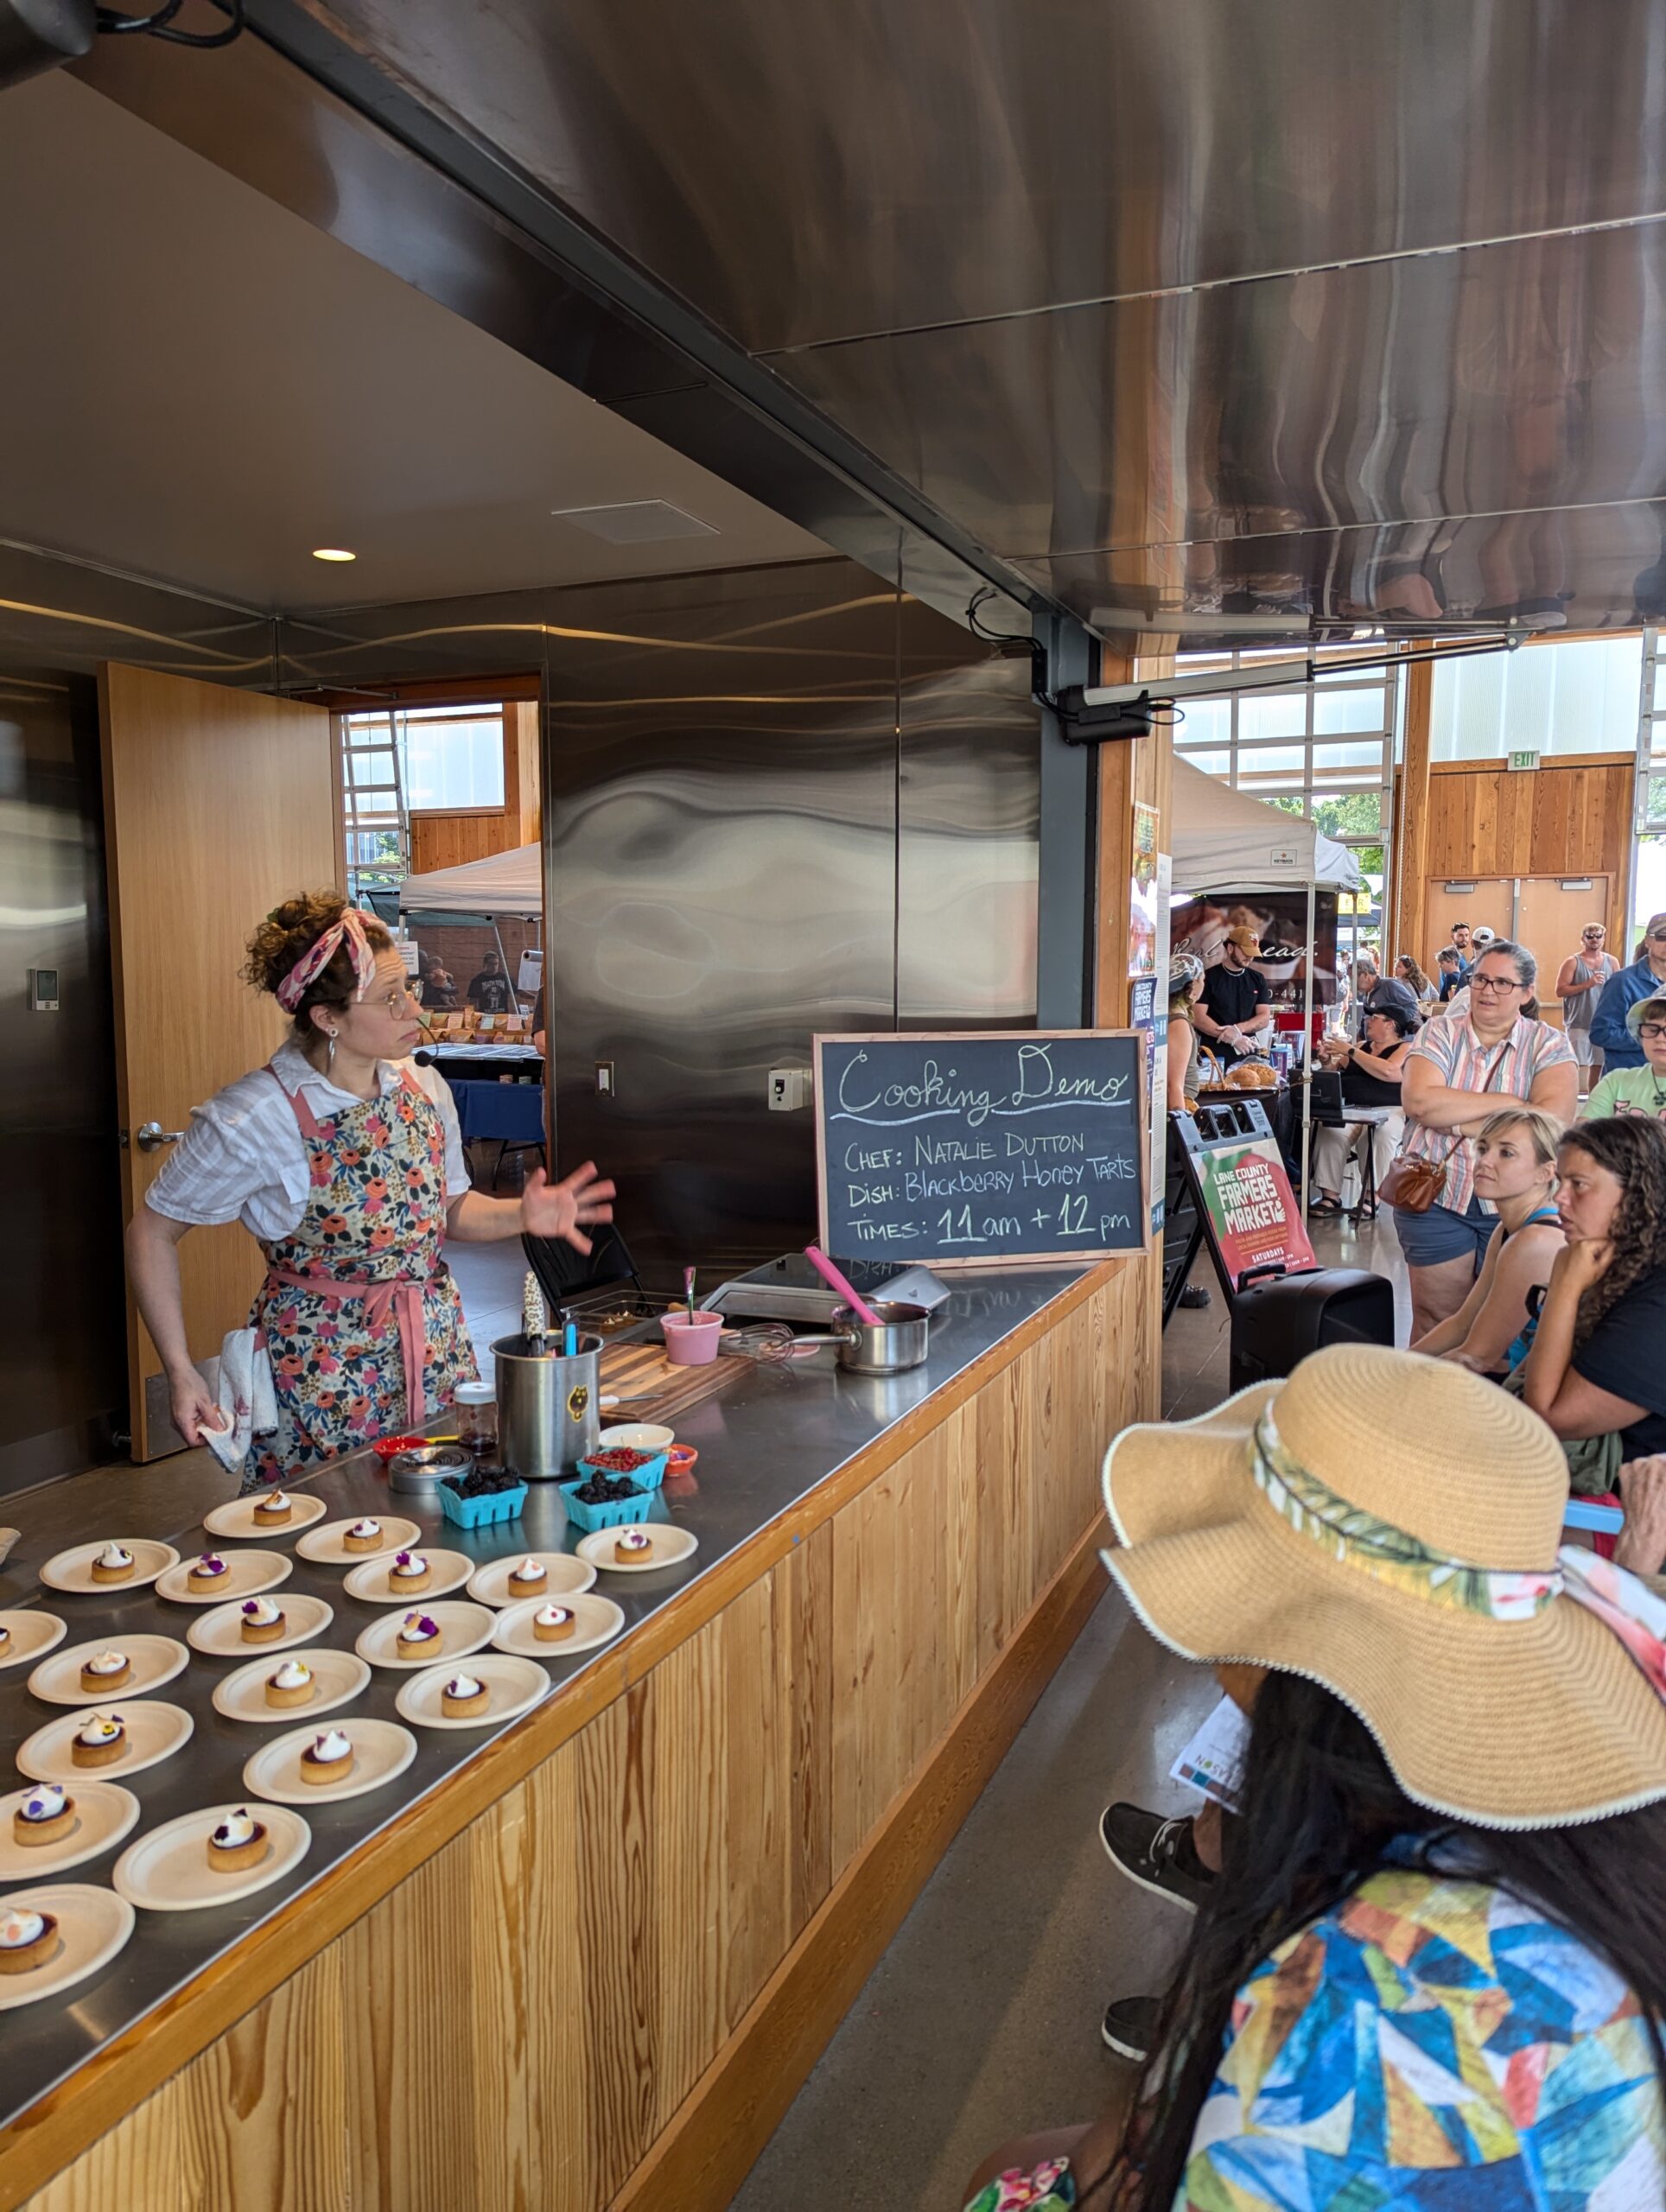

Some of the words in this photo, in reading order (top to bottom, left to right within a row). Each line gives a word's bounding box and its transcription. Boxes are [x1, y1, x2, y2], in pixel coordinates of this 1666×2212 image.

[1514, 752, 1536, 767] EXIT
[839, 1049, 1007, 1127] Cooking
[1012, 1043, 1129, 1105] Demo
[845, 1142, 902, 1173] CHEF:
[1004, 1133, 1084, 1157] DUTTON
[1021, 1159, 1084, 1187] Honey
[1213, 1171, 1236, 1185] LANE
[1235, 1163, 1269, 1180] COUNTY
[1217, 1174, 1278, 1211] FARMERS
[1056, 1193, 1097, 1236] 12
[1100, 1214, 1130, 1242] pm
[1224, 1200, 1277, 1235] MARKET
[1251, 1247, 1285, 1263] SATURDAYS
